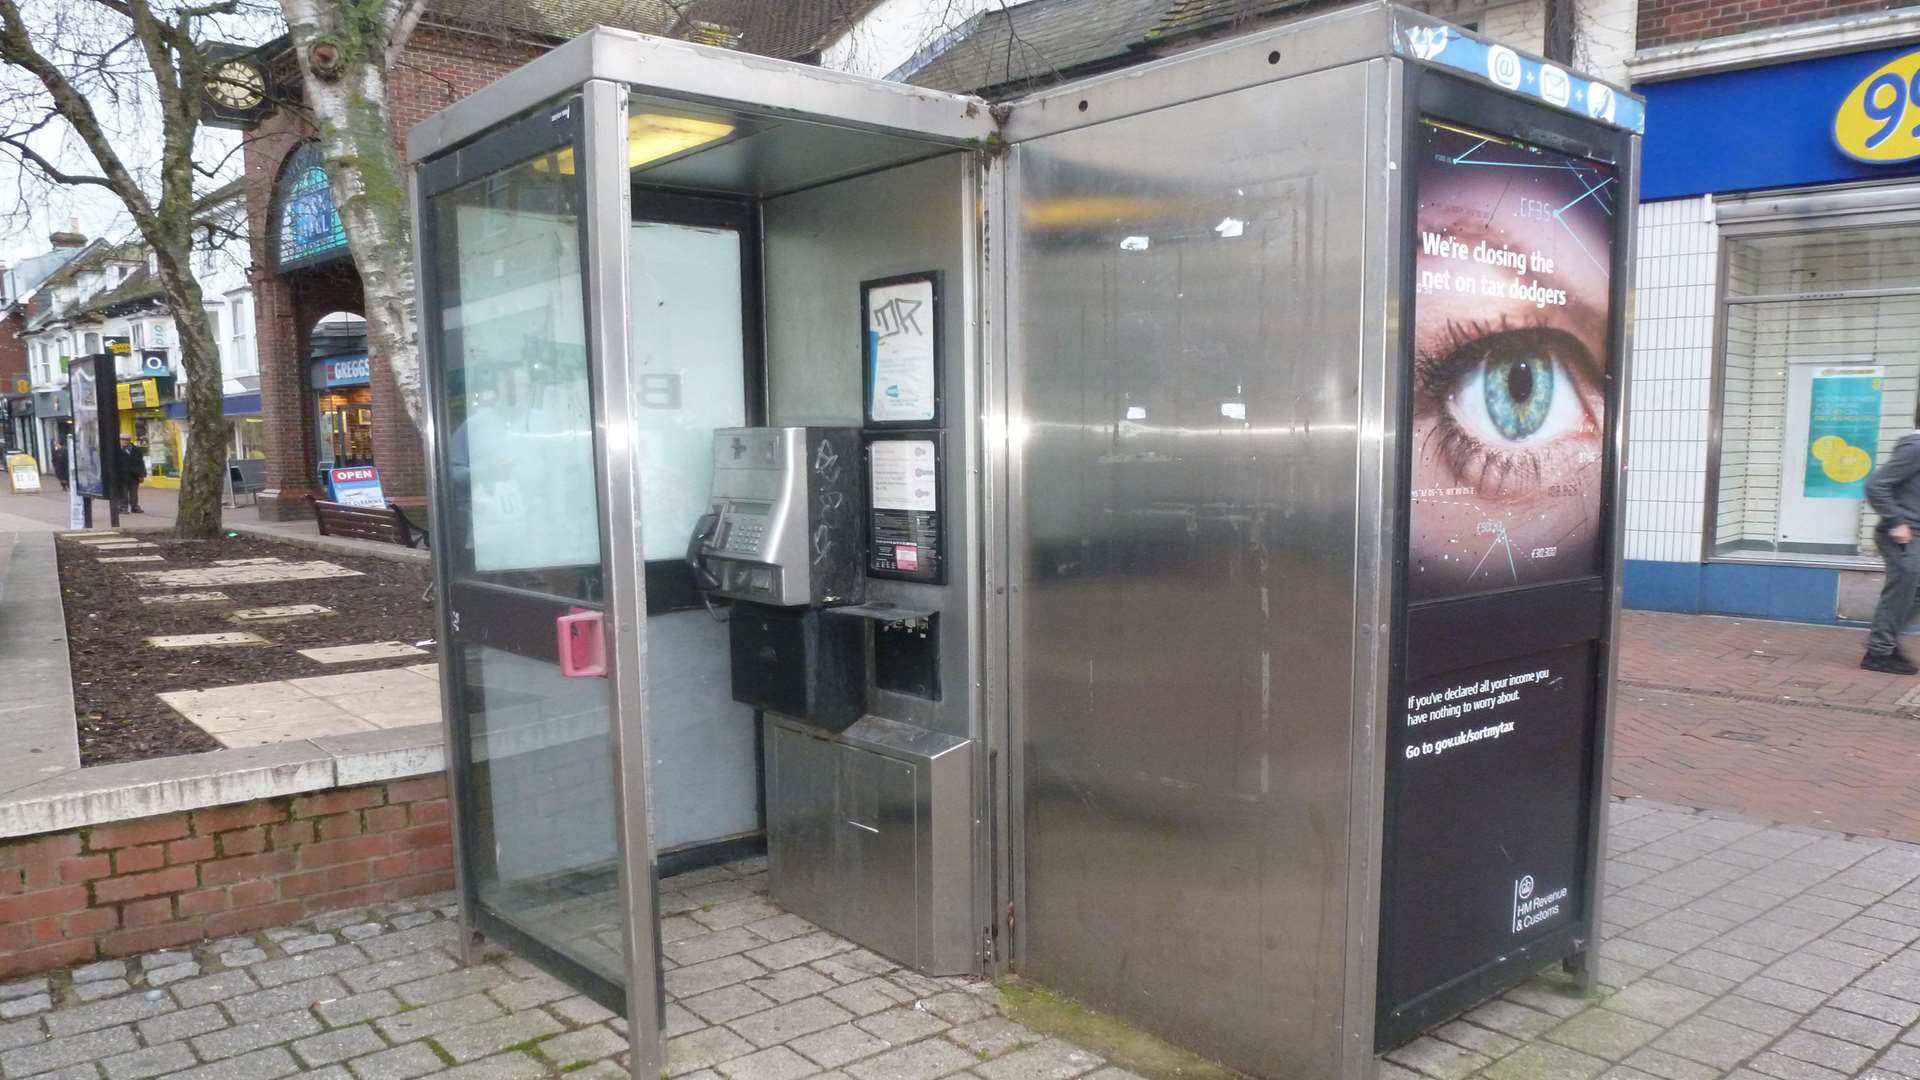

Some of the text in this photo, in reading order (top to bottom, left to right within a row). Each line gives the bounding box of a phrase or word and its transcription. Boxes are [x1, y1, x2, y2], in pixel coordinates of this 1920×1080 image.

[1862, 67, 1920, 150] 9
[1422, 232, 1555, 274] We're closing the
[1422, 271, 1567, 309] net on tax dodgers
[335, 358, 370, 379] GREGGS
[337, 470, 373, 480] OPEN
[1407, 690, 1521, 727] have nothing to worry about.
[1408, 669, 1550, 711] If you've declared all your income you
[1405, 721, 1515, 759] Go to gov.uk/sortmytax
[1516, 904, 1560, 932] & Customs
[1517, 887, 1568, 917] HM Revenue
